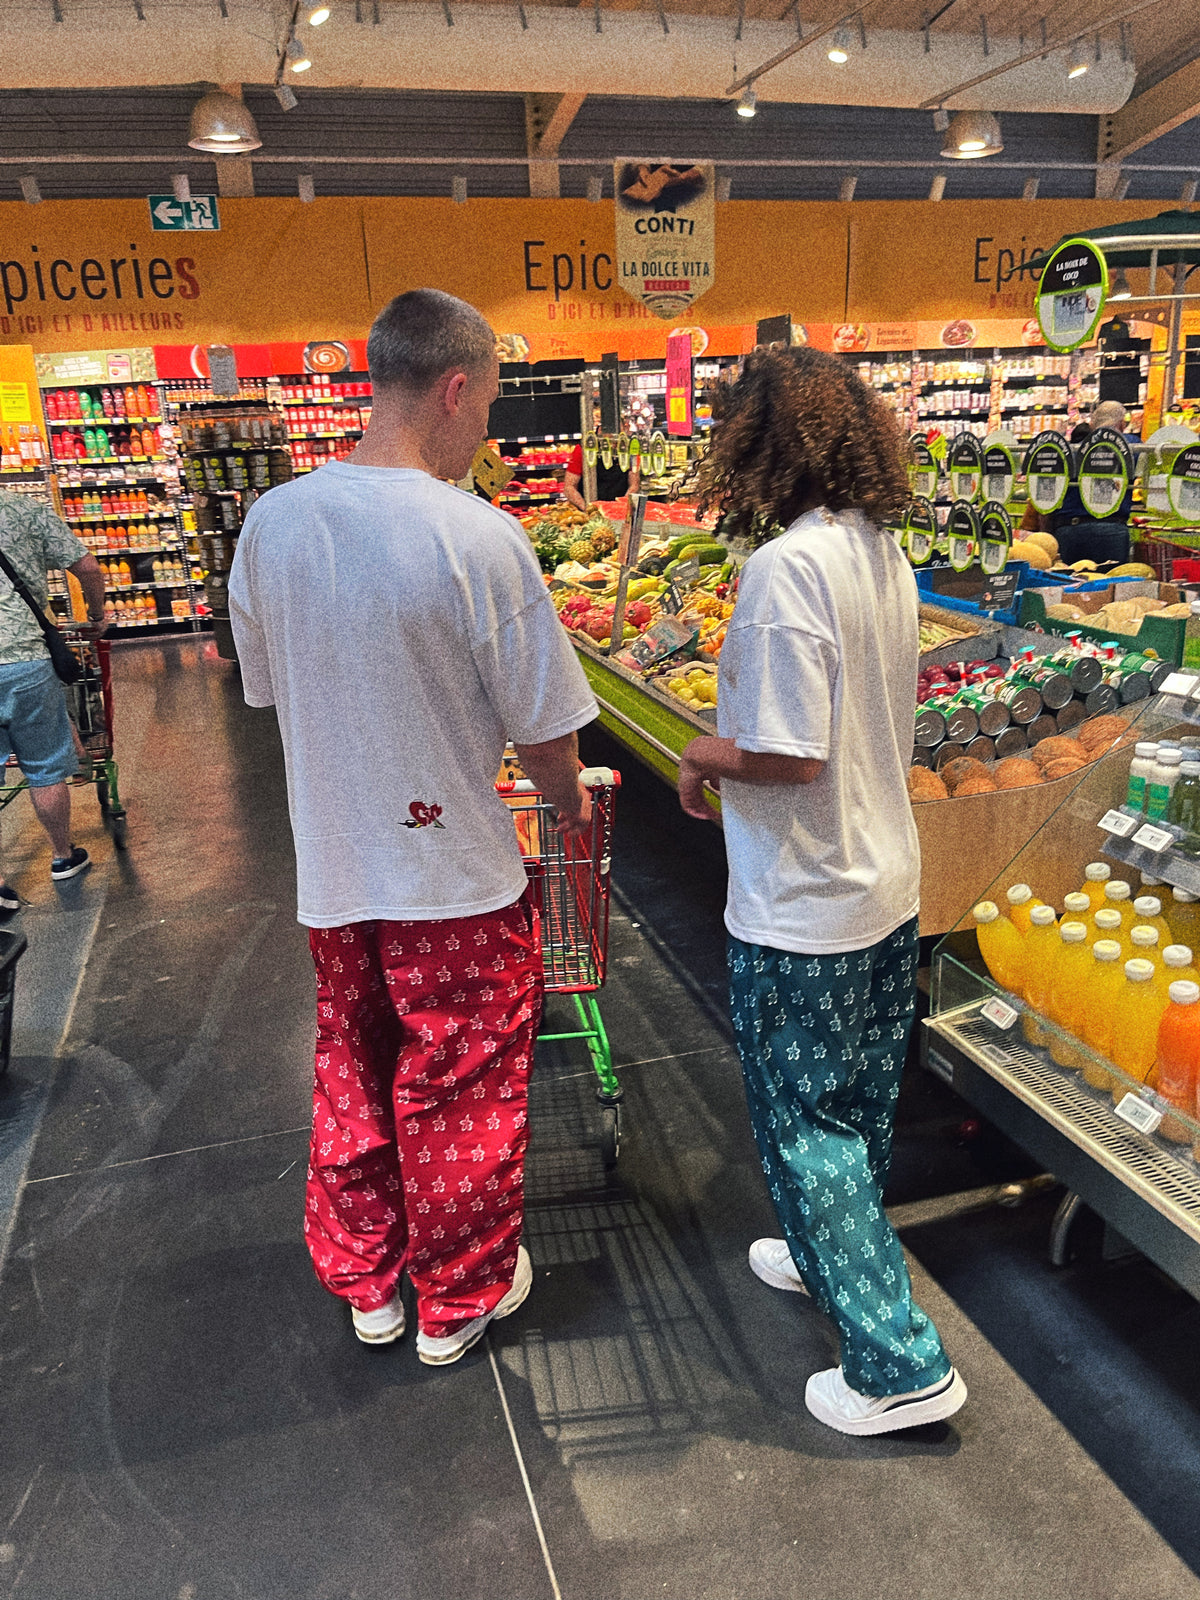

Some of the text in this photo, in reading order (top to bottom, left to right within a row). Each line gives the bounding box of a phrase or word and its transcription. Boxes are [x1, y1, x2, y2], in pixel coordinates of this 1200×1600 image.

[634, 217, 694, 235] CONTI
[622, 261, 710, 277] LA DOLCE VITA
[1062, 270, 1079, 282] COCO
[549, 303, 582, 320] D'ICI
[590, 303, 604, 319] ET
[53, 313, 72, 333] ET
[83, 311, 184, 332] D'AILLEURS
